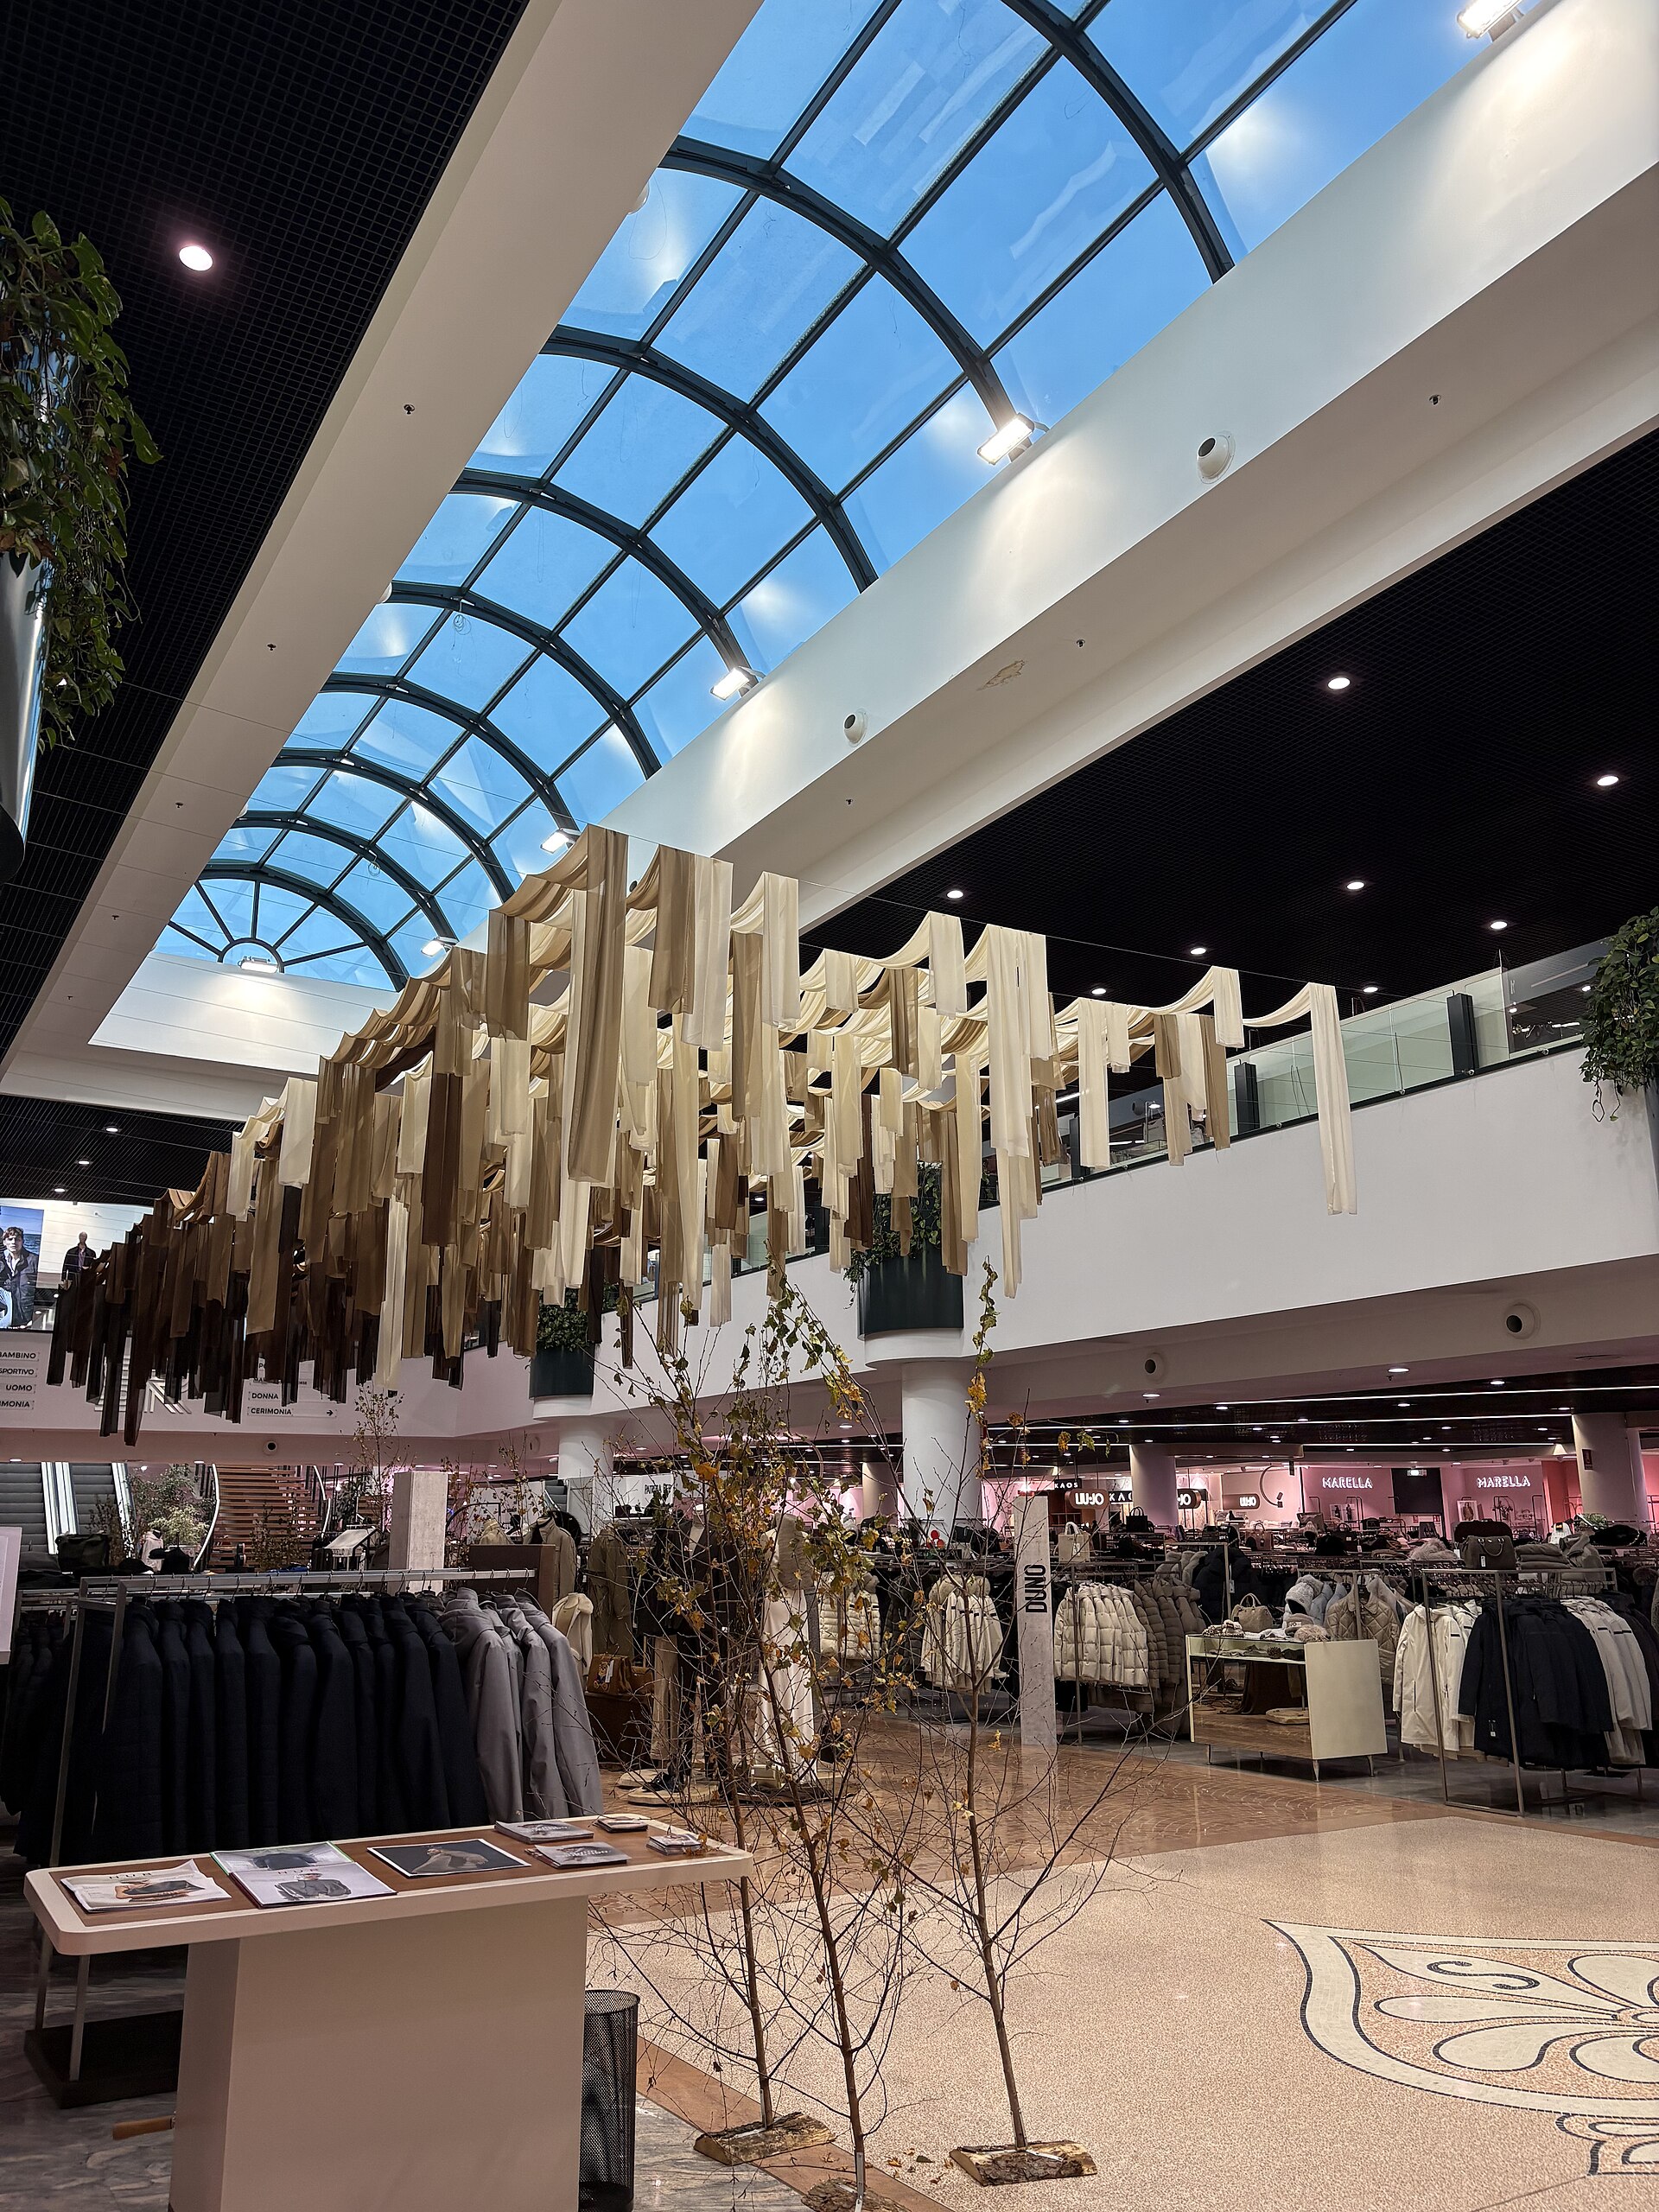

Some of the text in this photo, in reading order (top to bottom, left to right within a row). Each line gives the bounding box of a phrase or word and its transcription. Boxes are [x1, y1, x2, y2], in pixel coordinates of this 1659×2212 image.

[1322, 1477, 1373, 1489] MARELLA
[1476, 1475, 1531, 1488] MARELLA
[1023, 1564, 1047, 1613] DUNO
